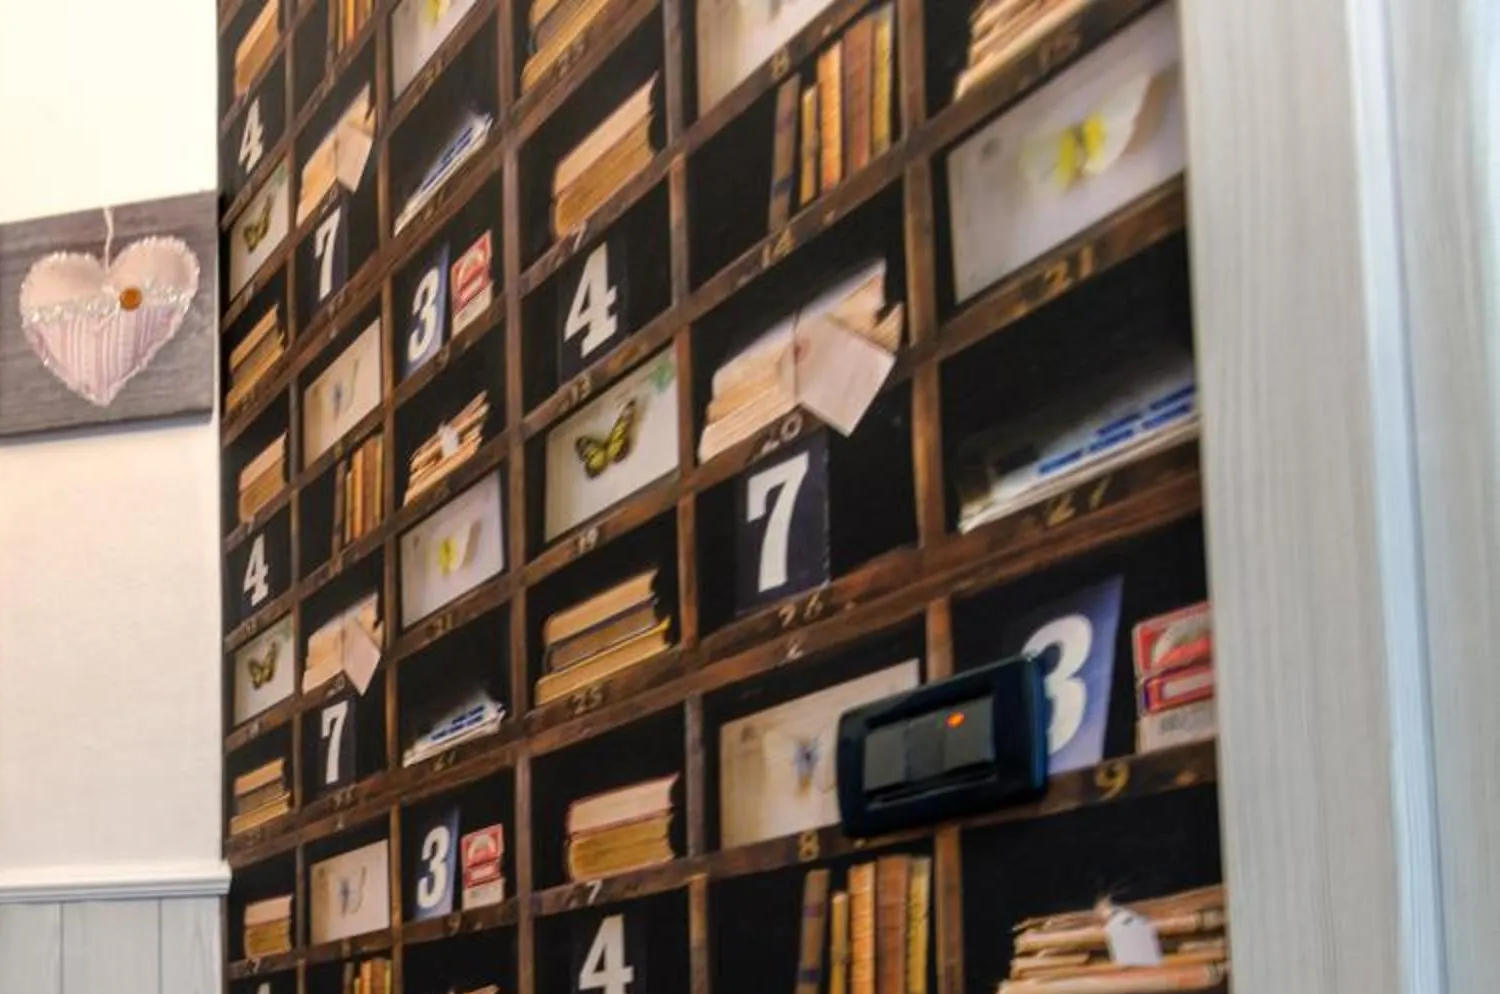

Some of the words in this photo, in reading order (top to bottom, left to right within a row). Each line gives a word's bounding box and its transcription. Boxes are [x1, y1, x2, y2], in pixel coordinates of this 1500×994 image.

[770, 47, 791, 79] 8
[314, 205, 341, 301] 7
[406, 266, 440, 363] 3
[563, 241, 618, 358] 4
[747, 450, 810, 593] 7
[243, 534, 270, 607] 4
[1021, 613, 1094, 755] 3
[321, 700, 349, 785] 7
[1094, 761, 1130, 800] 9
[416, 825, 451, 909] 3
[799, 830, 820, 861] 8
